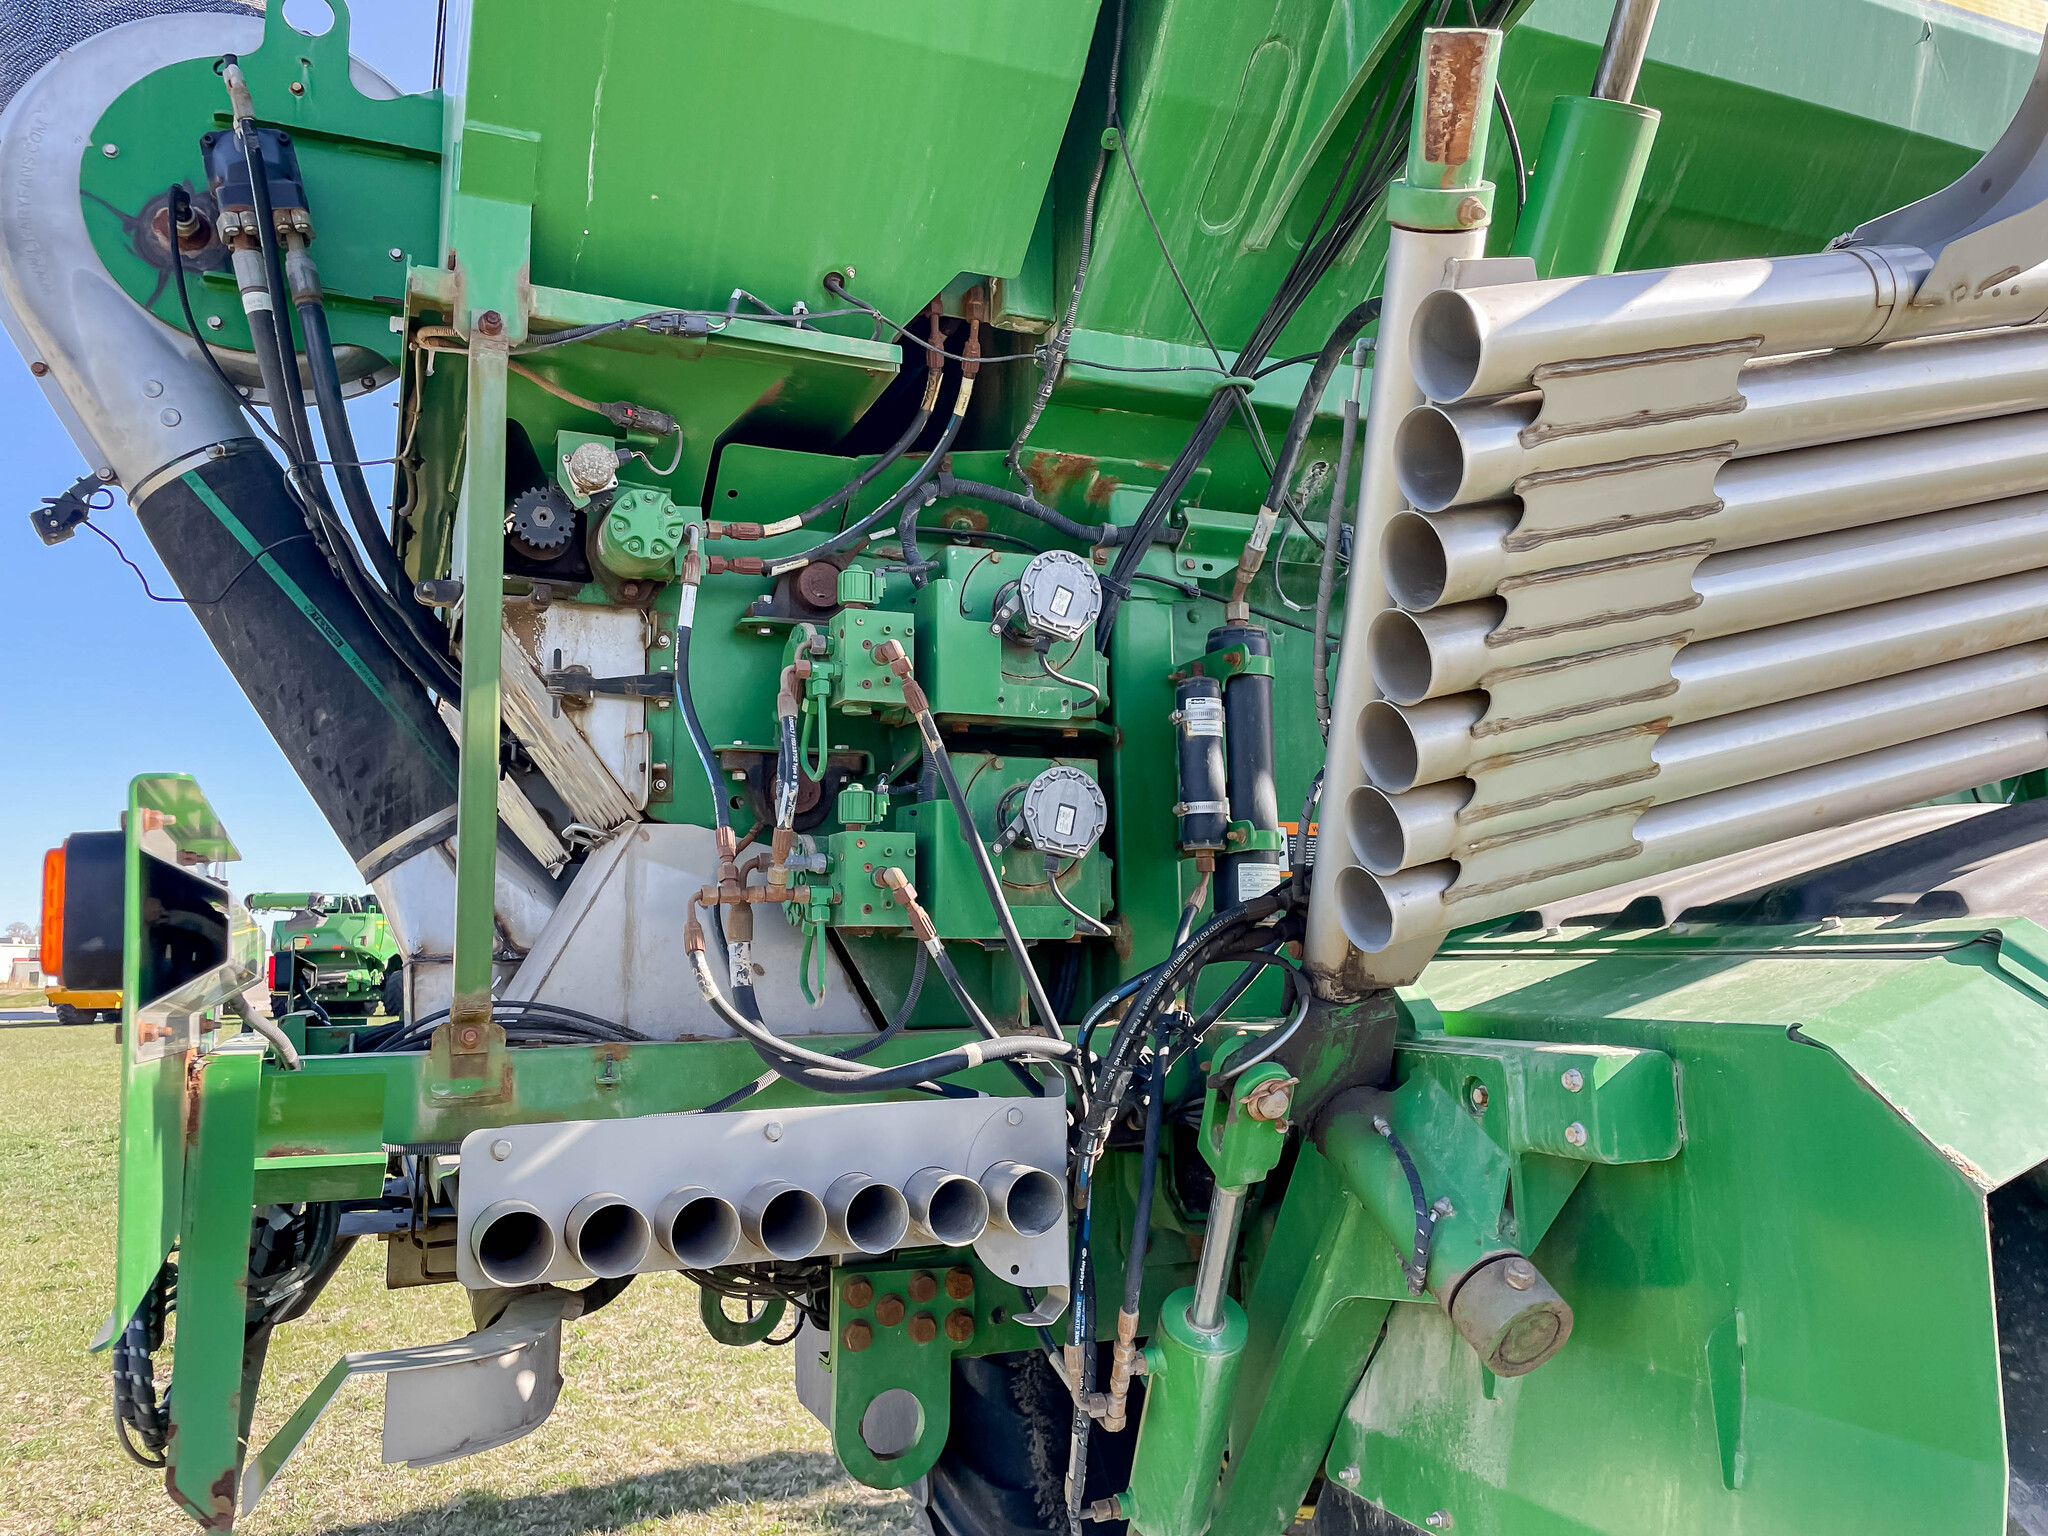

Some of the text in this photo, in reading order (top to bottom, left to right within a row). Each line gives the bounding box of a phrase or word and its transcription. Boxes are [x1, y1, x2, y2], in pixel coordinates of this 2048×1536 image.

[1209, 919, 1225, 933] 11237
[1199, 930, 1210, 941] R17
[1187, 940, 1198, 952] SAE
[1172, 948, 1189, 968] 100R17
[1145, 993, 1156, 1007] Type
[1119, 1037, 1130, 1058] esistant
